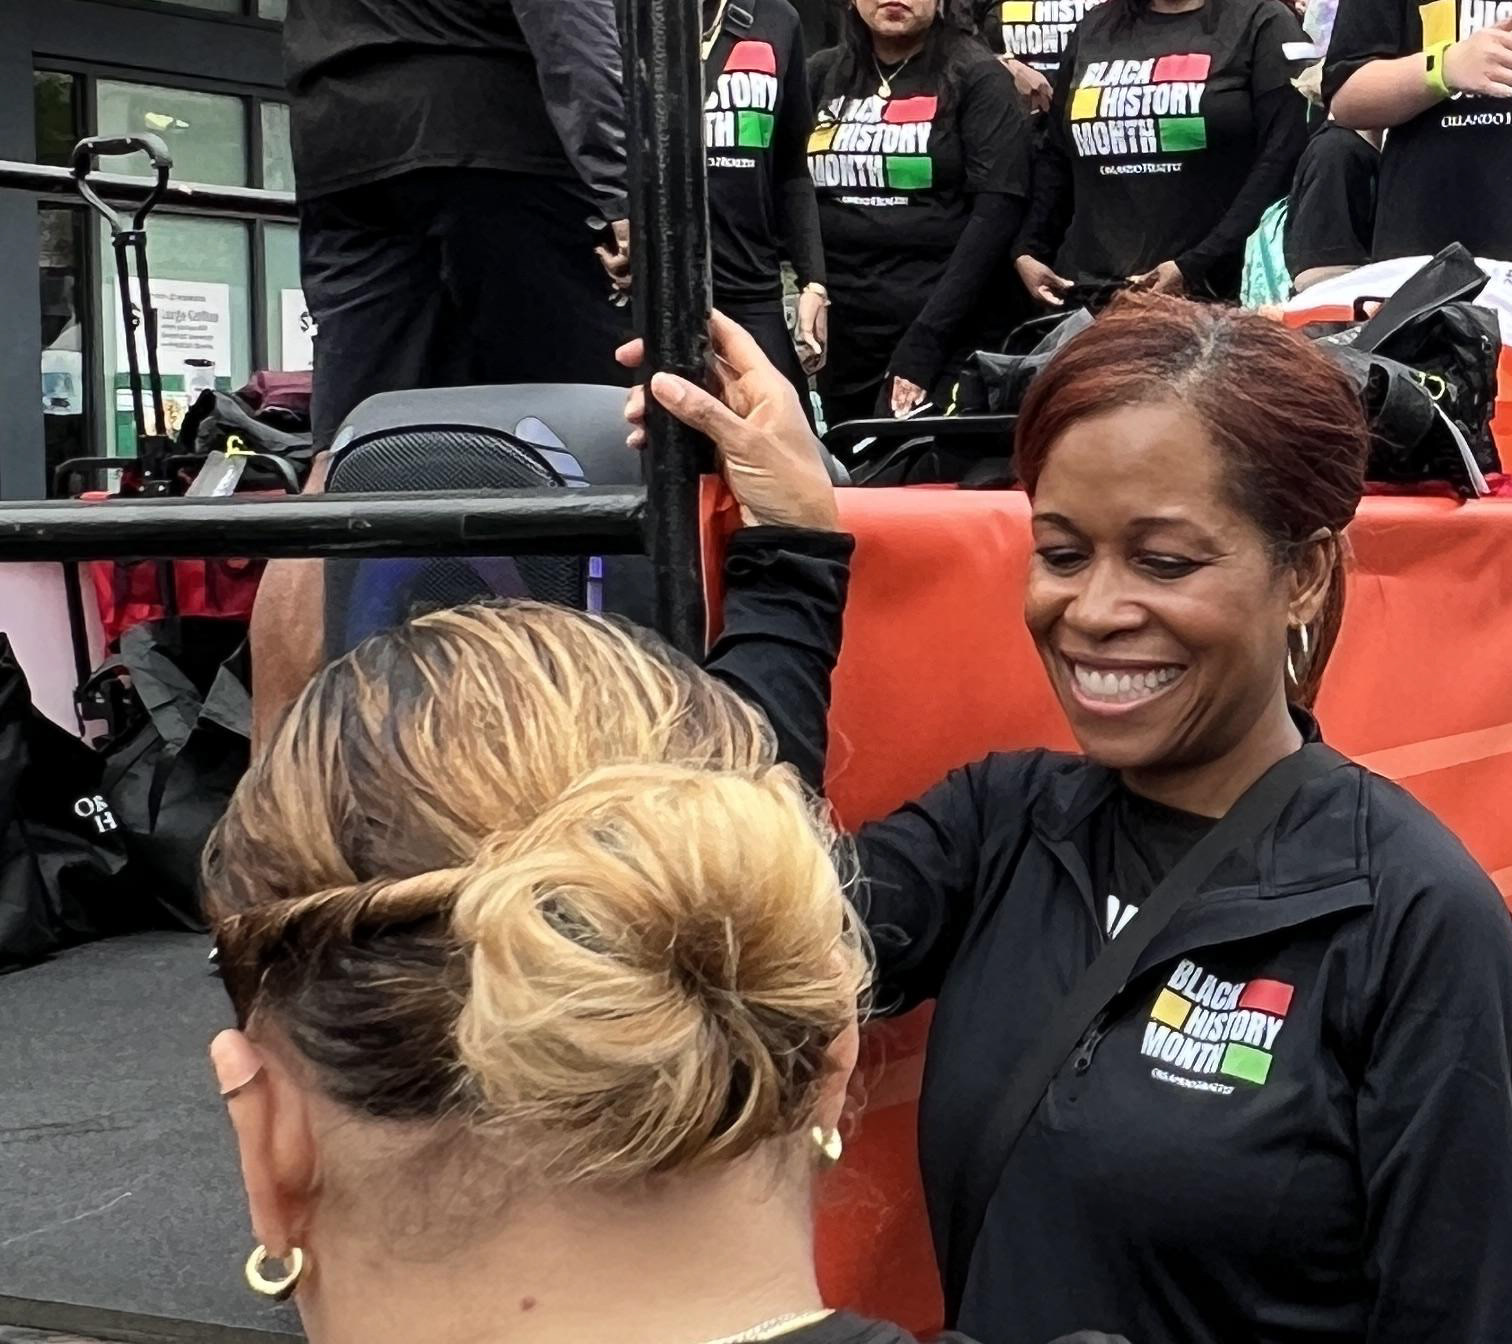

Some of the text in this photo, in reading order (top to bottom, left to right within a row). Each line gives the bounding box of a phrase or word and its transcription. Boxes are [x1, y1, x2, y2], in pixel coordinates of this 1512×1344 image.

[1080, 57, 1155, 89] BLACK
[1099, 82, 1206, 118] HISTORY
[1071, 118, 1157, 157] MONTH
[1166, 958, 1247, 1011] BLACK
[1140, 1020, 1227, 1075] MONTH
[1183, 1005, 1284, 1051] HISTORY
